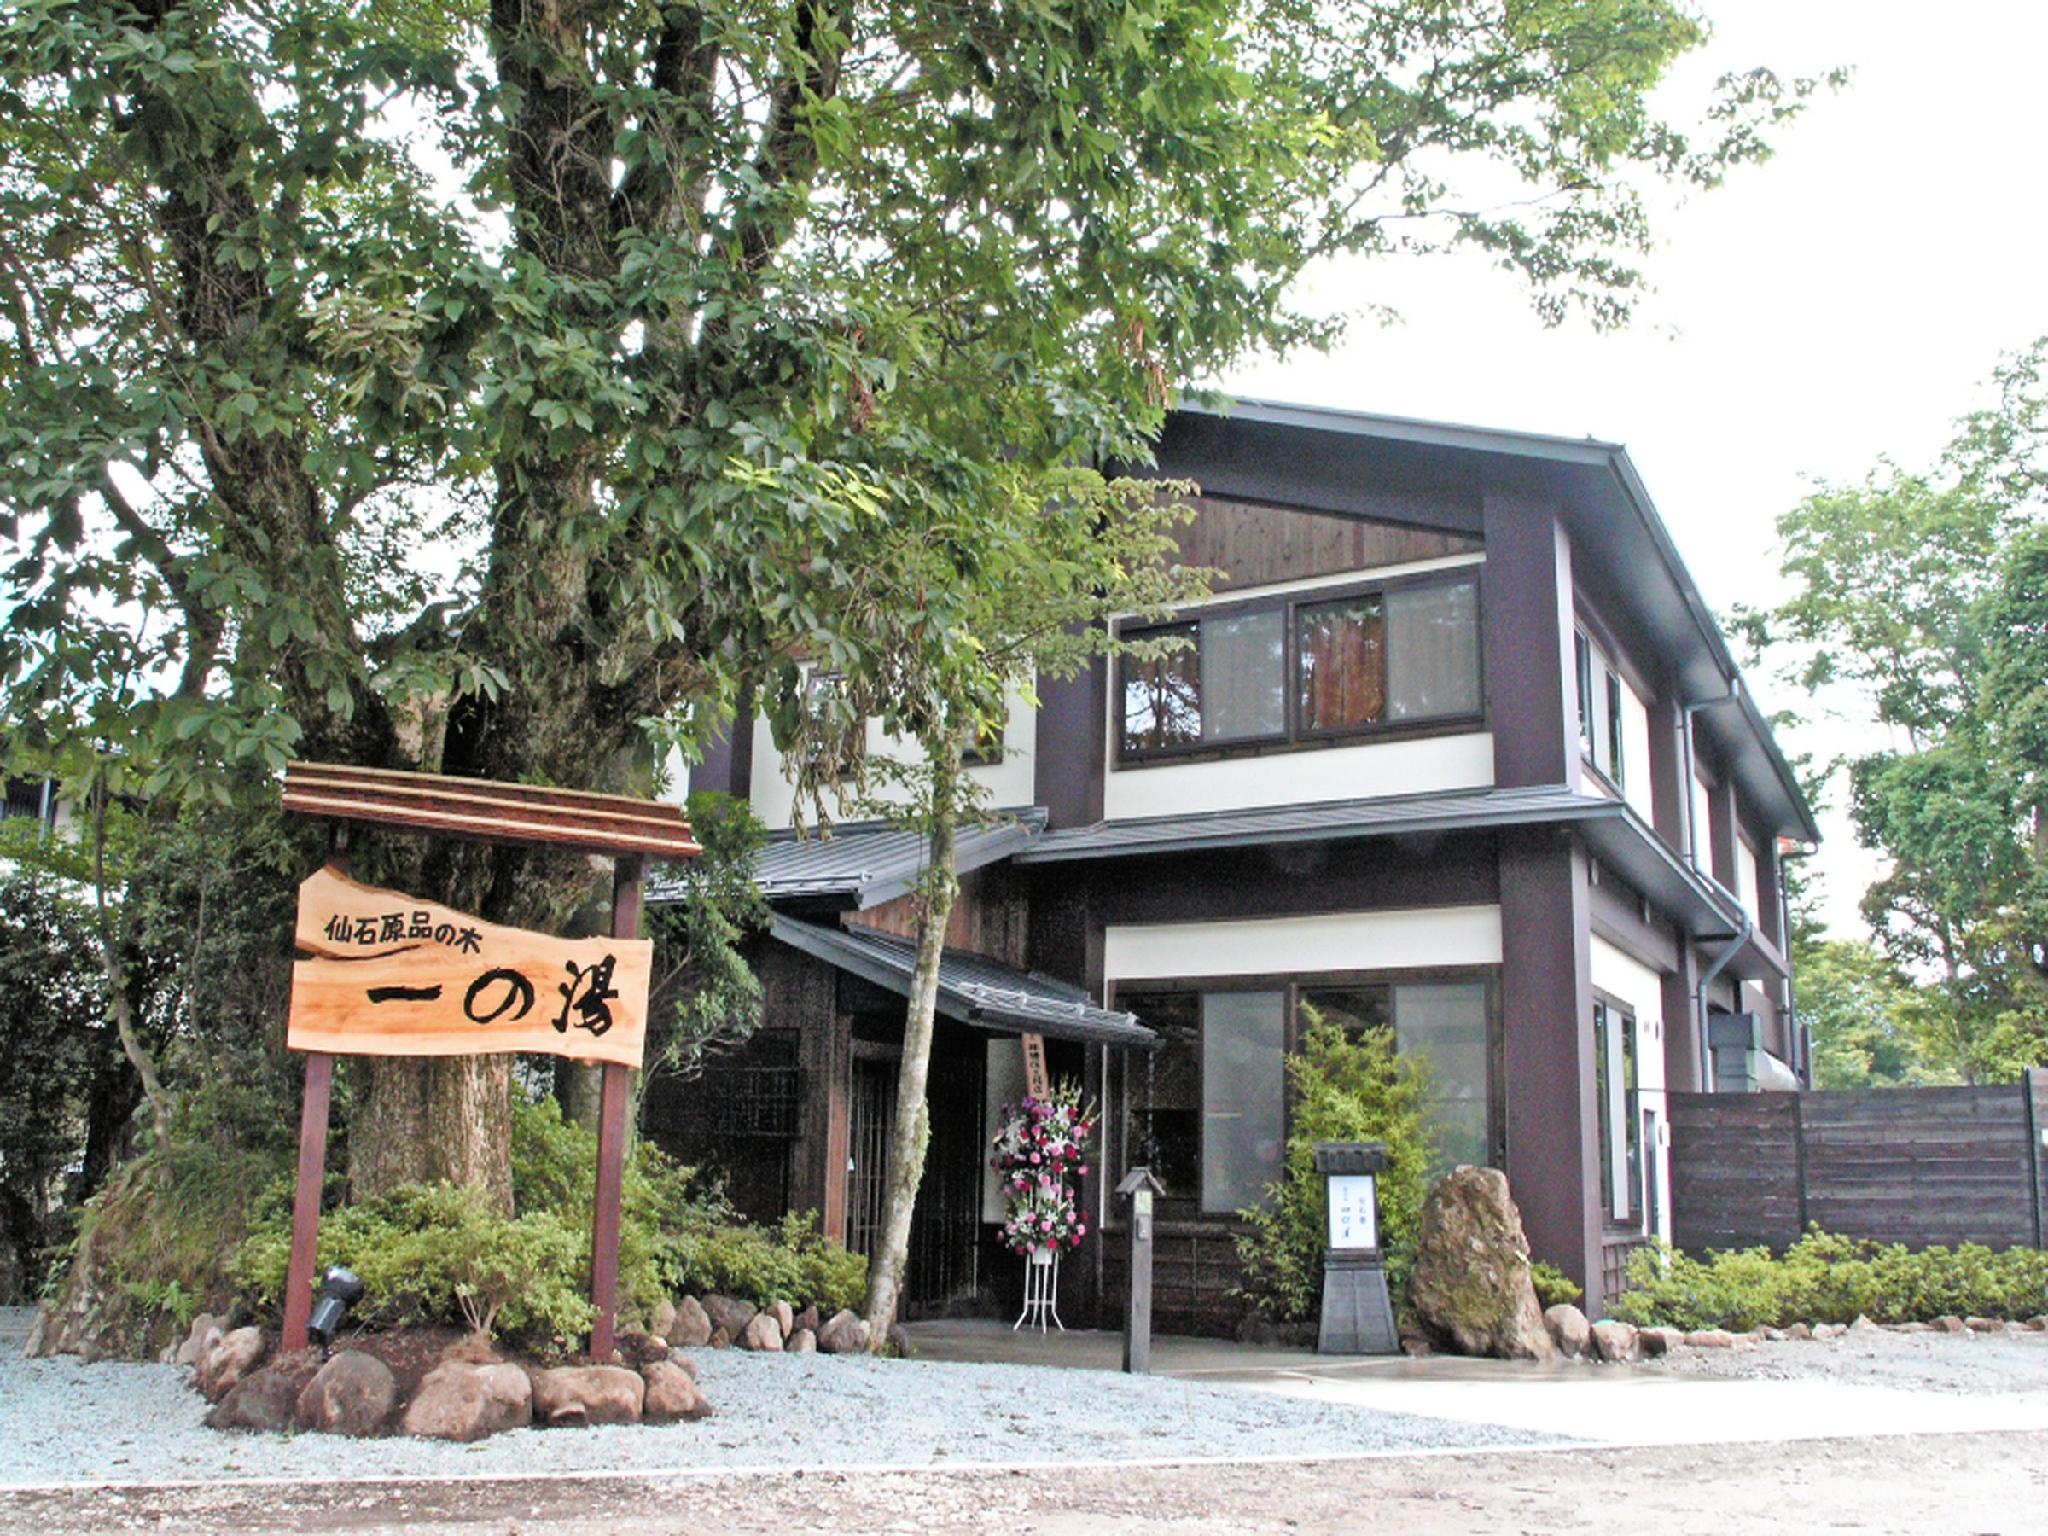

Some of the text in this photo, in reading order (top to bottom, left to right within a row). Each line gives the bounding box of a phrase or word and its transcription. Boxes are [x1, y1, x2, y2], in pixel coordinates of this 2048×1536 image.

[323, 910, 483, 955] 仙石原品の木
[367, 953, 619, 1037] 一の湯
